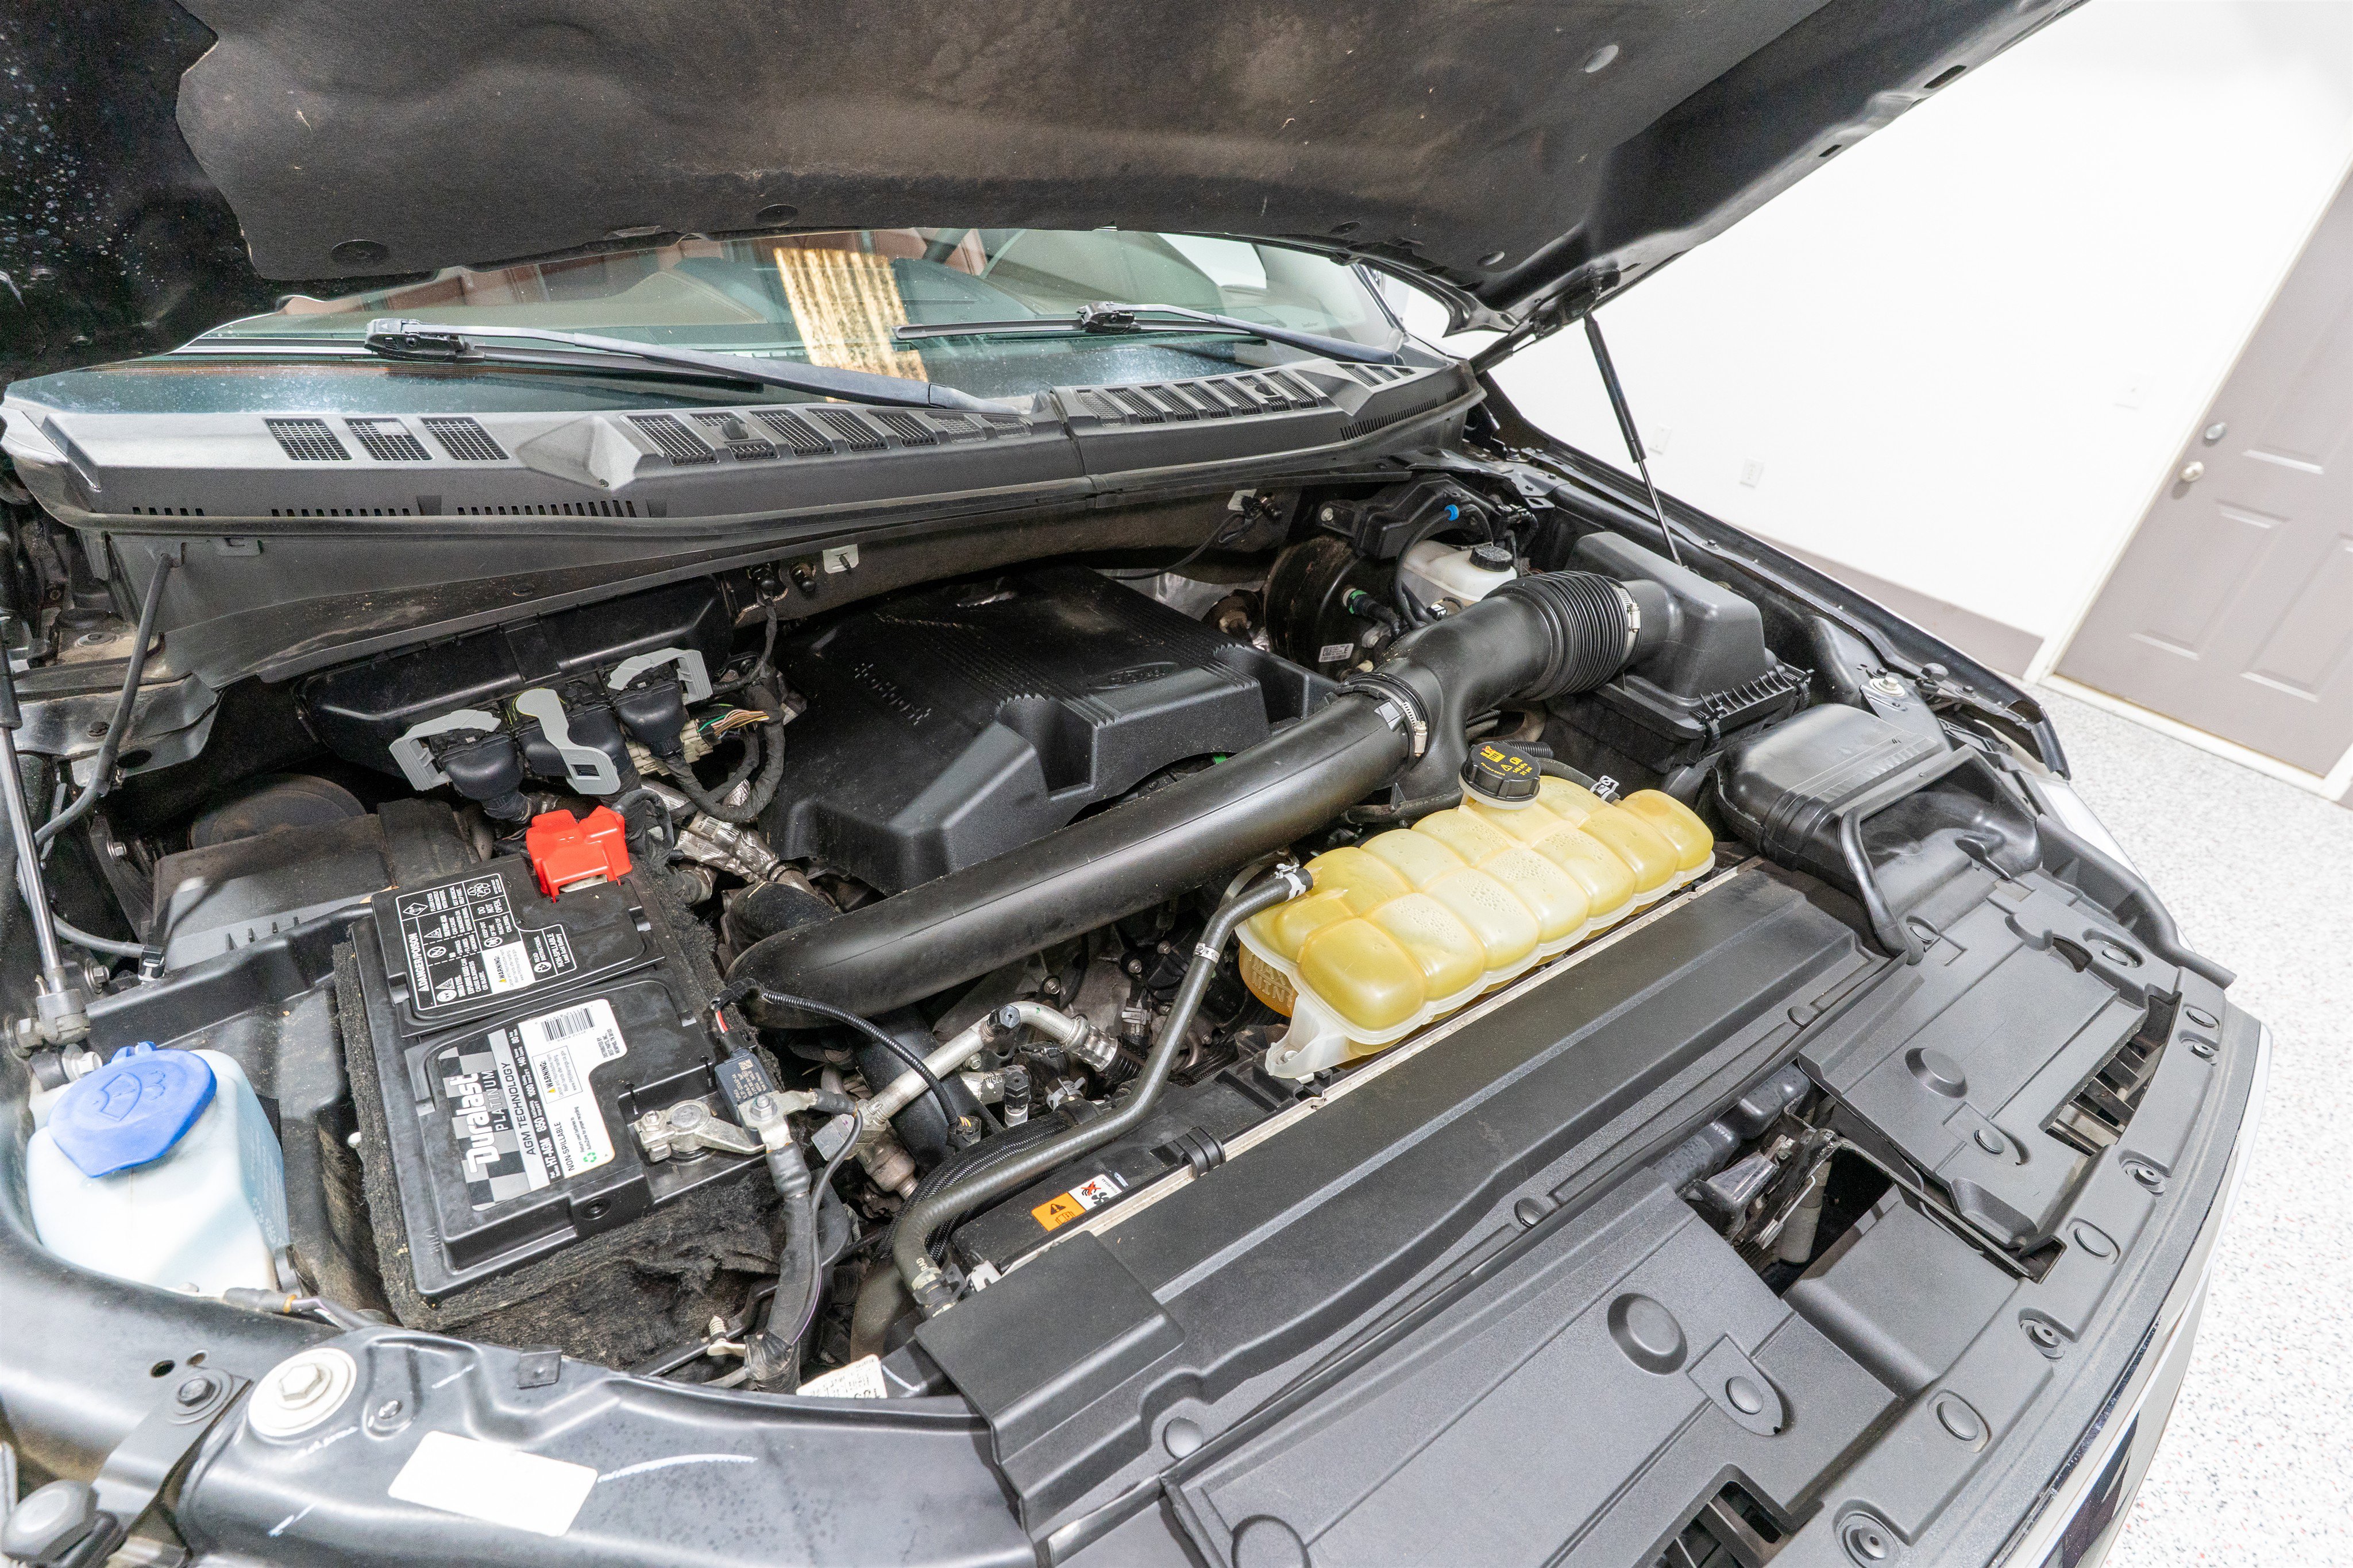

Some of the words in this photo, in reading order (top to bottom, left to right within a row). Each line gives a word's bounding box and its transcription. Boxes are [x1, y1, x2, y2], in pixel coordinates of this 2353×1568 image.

[449, 886, 457, 899] MEDICAL
[477, 906, 485, 914] DO
[485, 902, 494, 913] NOT
[492, 898, 503, 913] OPEN.
[456, 915, 465, 932] BLINDNESS
[464, 918, 472, 930] SEVERE
[496, 922, 504, 934] REACH
[502, 914, 512, 932] CHILDREN.
[533, 935, 546, 960] INSTRUCTIONS.
[554, 933, 565, 946] Battery
[546, 932, 565, 967] NON-SPILLABLE
[558, 946, 566, 954] Acid
[408, 932, 428, 986] DANGER/POISON
[562, 953, 570, 963] Lead
[468, 960, 479, 980] BLINDNESS
[493, 955, 504, 978] WARNING:
[478, 971, 487, 984] INJURY.
[473, 980, 481, 992] CAUSE
[1251, 971, 1285, 1003] MIN
[511, 1035, 519, 1044] 80
[598, 1041, 608, 1057] DISTRIBUTED
[517, 1056, 527, 1067] 140
[539, 1060, 554, 1088] WARNING:
[500, 1060, 528, 1129] TECHNOLOGY
[525, 1083, 536, 1097] 1000
[480, 1067, 509, 1133] PLATINUM
[573, 1106, 583, 1120] recycling
[448, 1069, 501, 1174] Duralast
[533, 1115, 547, 1133] 850
[570, 1120, 578, 1133] batteries
[521, 1130, 536, 1157] AGM
[553, 1121, 575, 1171] NON-SPILLABLE
[583, 1134, 592, 1150] AutoZone
[539, 1137, 557, 1167] H7-AGM
